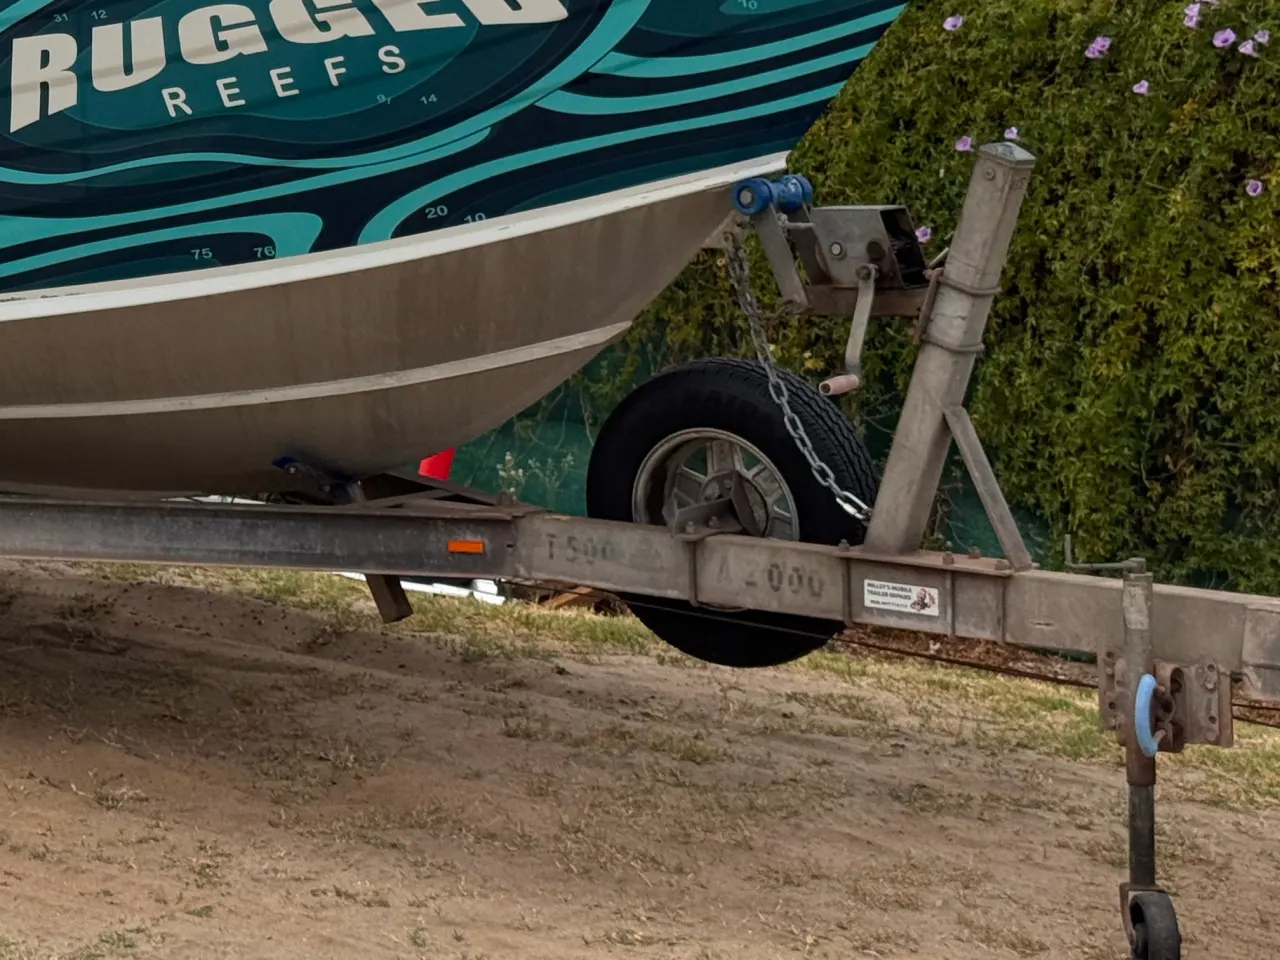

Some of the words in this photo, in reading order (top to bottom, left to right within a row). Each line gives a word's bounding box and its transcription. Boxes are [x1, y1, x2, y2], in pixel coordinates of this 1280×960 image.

[52, 13, 68, 23] 31
[90, 9, 107, 20] 12
[161, 45, 406, 118] REEFS
[419, 93, 437, 105] 14
[424, 205, 447, 219] 20
[189, 248, 212, 260] 75
[252, 245, 274, 258] 76
[867, 589, 889, 597] TRAILER
